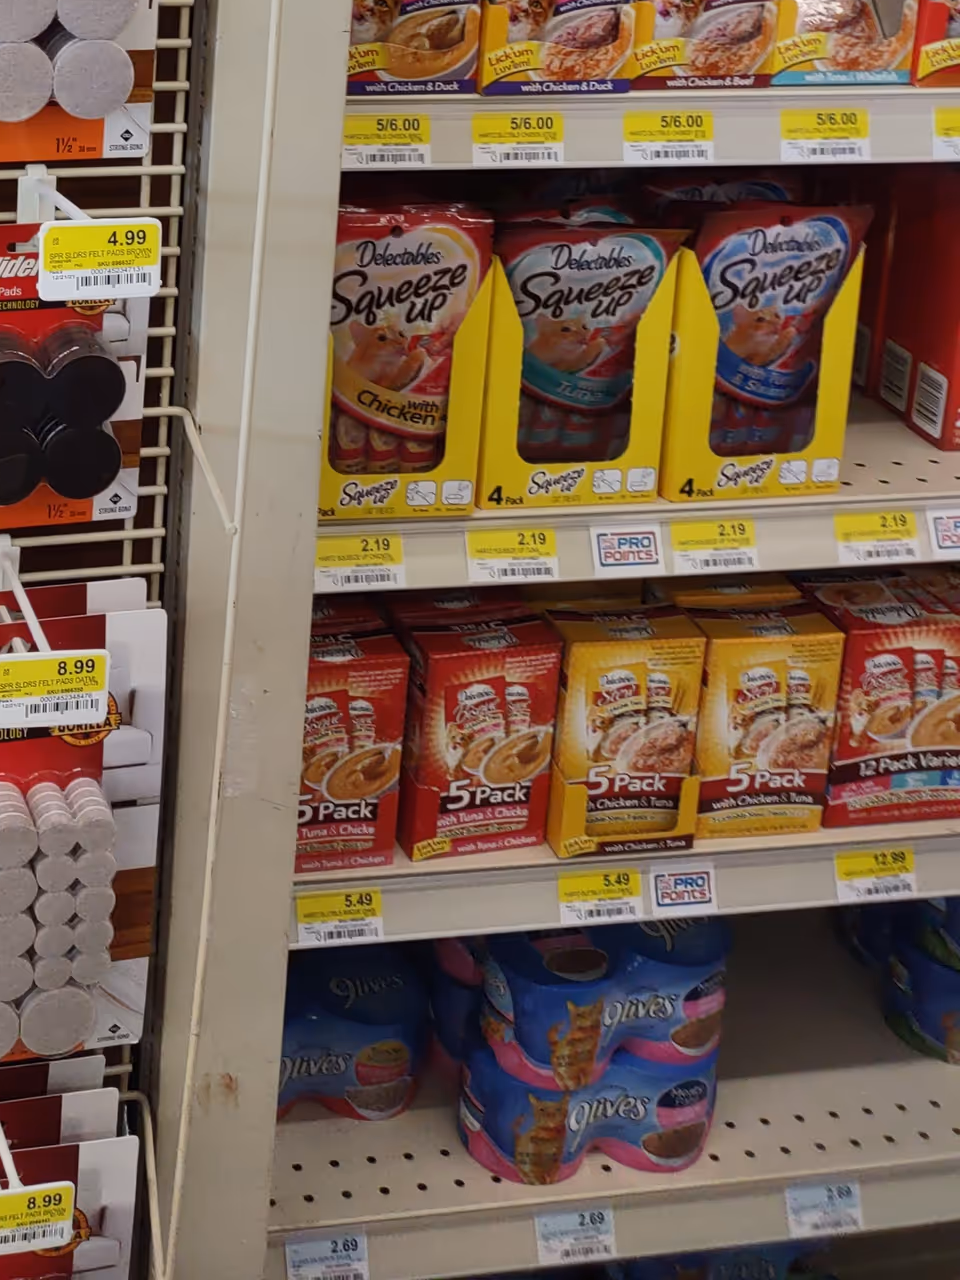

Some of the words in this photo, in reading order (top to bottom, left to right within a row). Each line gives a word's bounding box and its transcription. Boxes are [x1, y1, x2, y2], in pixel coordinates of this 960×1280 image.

[365, 83, 386, 92] with
[388, 82, 425, 92] Chicken
[426, 83, 433, 91] &
[435, 83, 459, 92] Duck
[689, 78, 724, 87] Chicken
[732, 77, 754, 87] Beef
[376, 119, 420, 131] 5/6.00
[816, 112, 857, 126] 5/6.00
[108, 230, 146, 246] 4.99
[712, 249, 842, 310] Squeeze
[357, 390, 436, 426] Chicken
[407, 400, 439, 414] with
[718, 523, 746, 537] 2.19
[518, 532, 546, 546] 2.19
[58, 659, 95, 675] 8.99
[587, 765, 610, 793] 5
[615, 773, 667, 793] Pack
[726, 762, 750, 793] 5
[754, 770, 805, 789] Pack
[712, 798, 733, 810] with
[734, 796, 778, 808] Chicken
[790, 794, 814, 805] Tuna
[674, 875, 705, 890] PRO
[345, 893, 373, 907] 5.49
[27, 1193, 62, 1210] 8.99
[331, 1238, 358, 1253] 2.69
